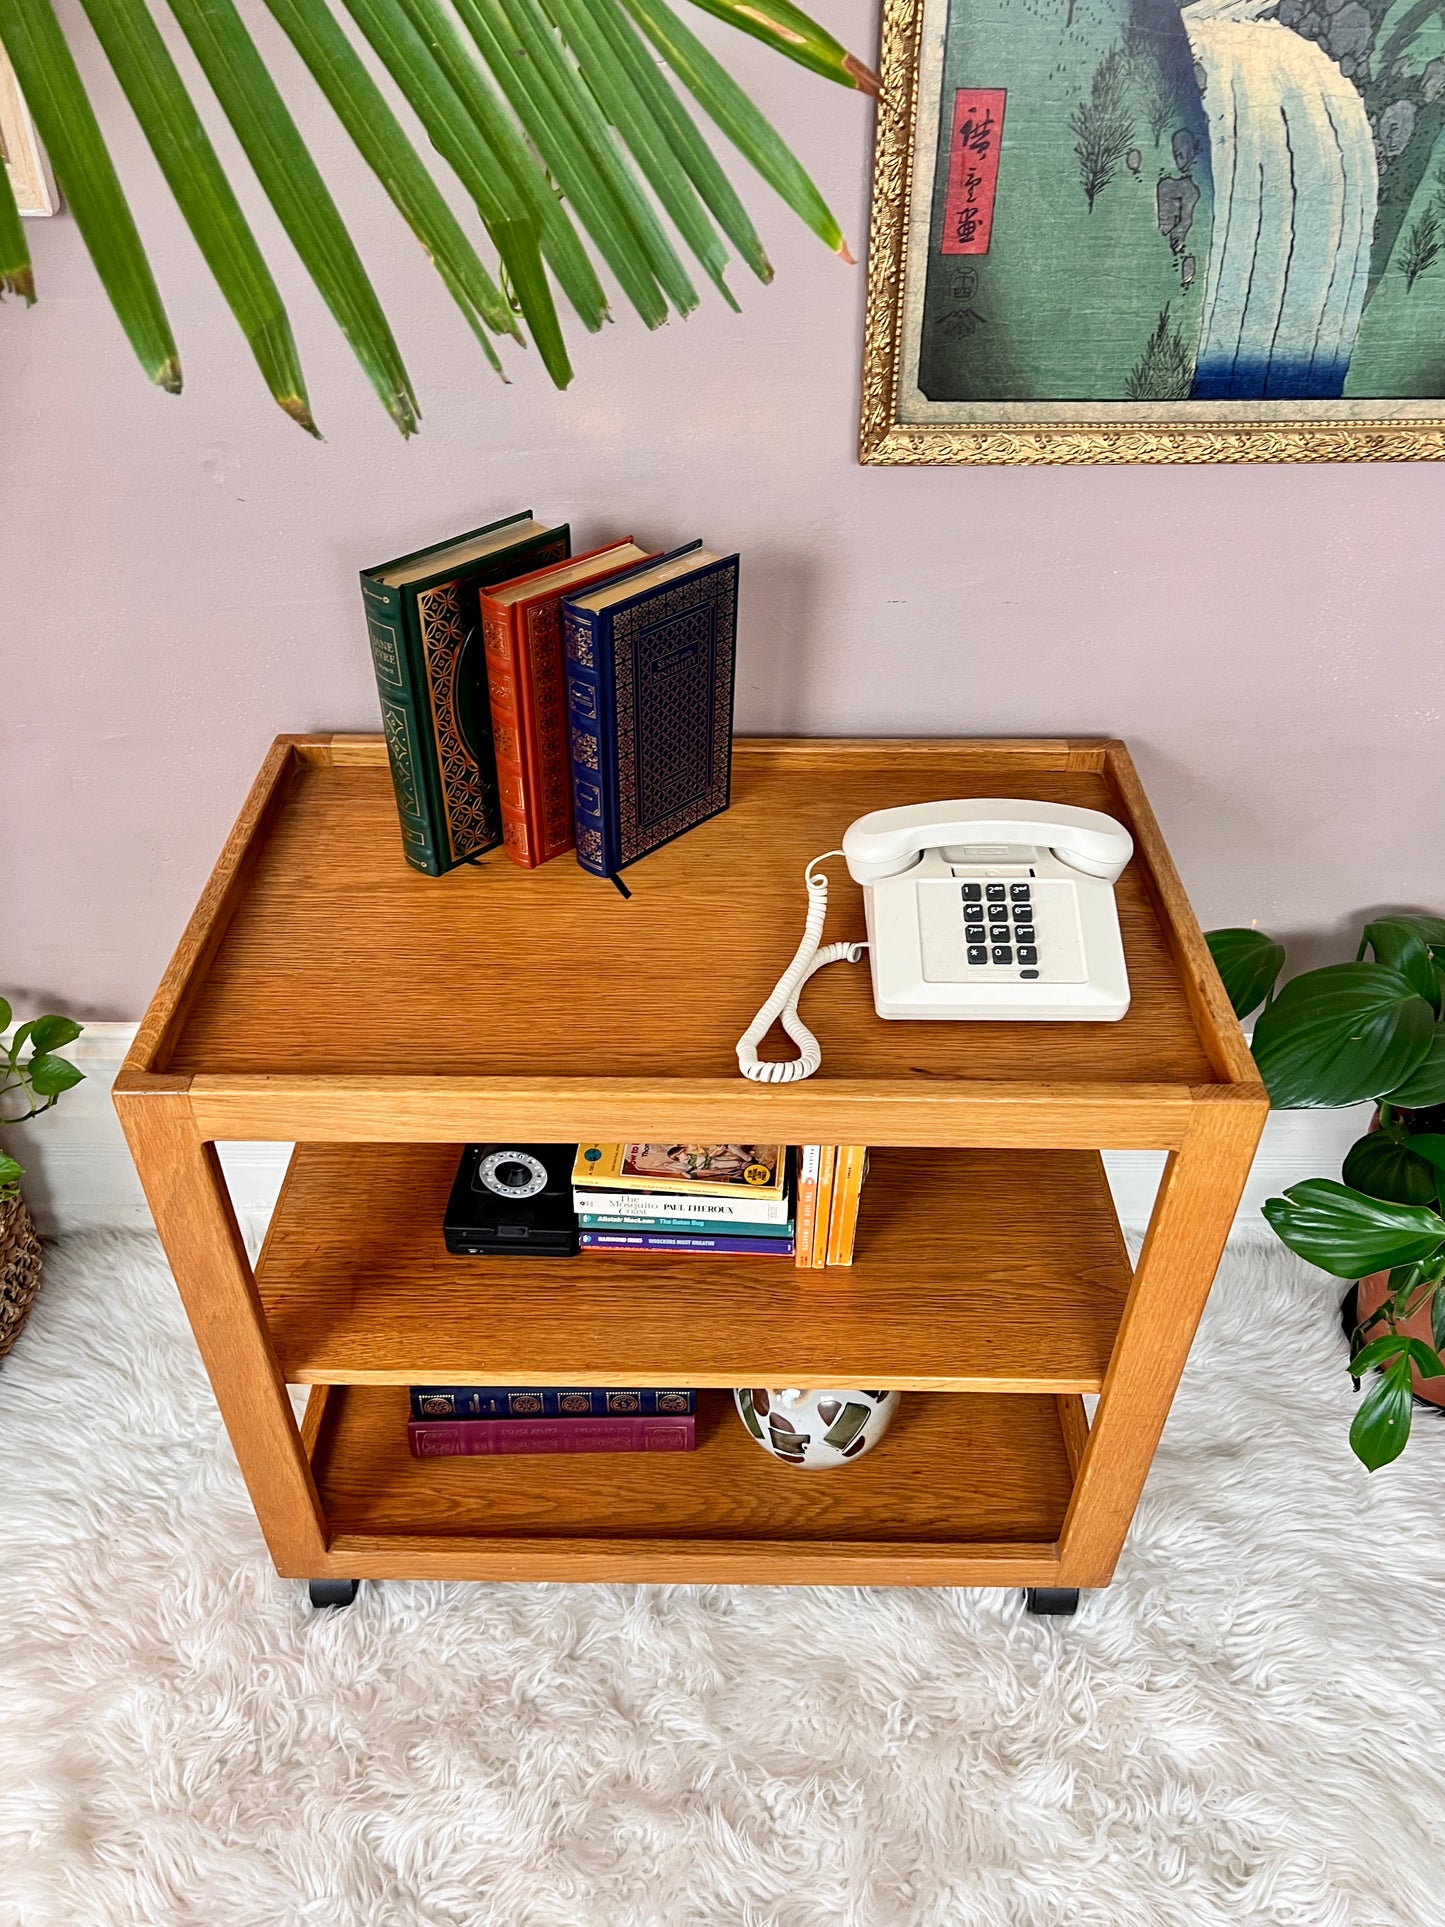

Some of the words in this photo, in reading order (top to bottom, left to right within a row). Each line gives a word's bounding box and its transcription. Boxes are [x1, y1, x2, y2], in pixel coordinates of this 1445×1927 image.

[630, 1145, 639, 1154] to
[621, 1195, 640, 1203] The
[609, 1200, 658, 1210] Mosquito
[663, 1203, 686, 1211] PAUL
[688, 1204, 734, 1214] THEROUX
[618, 1207, 647, 1215] Coast
[691, 1220, 705, 1228] Bug
